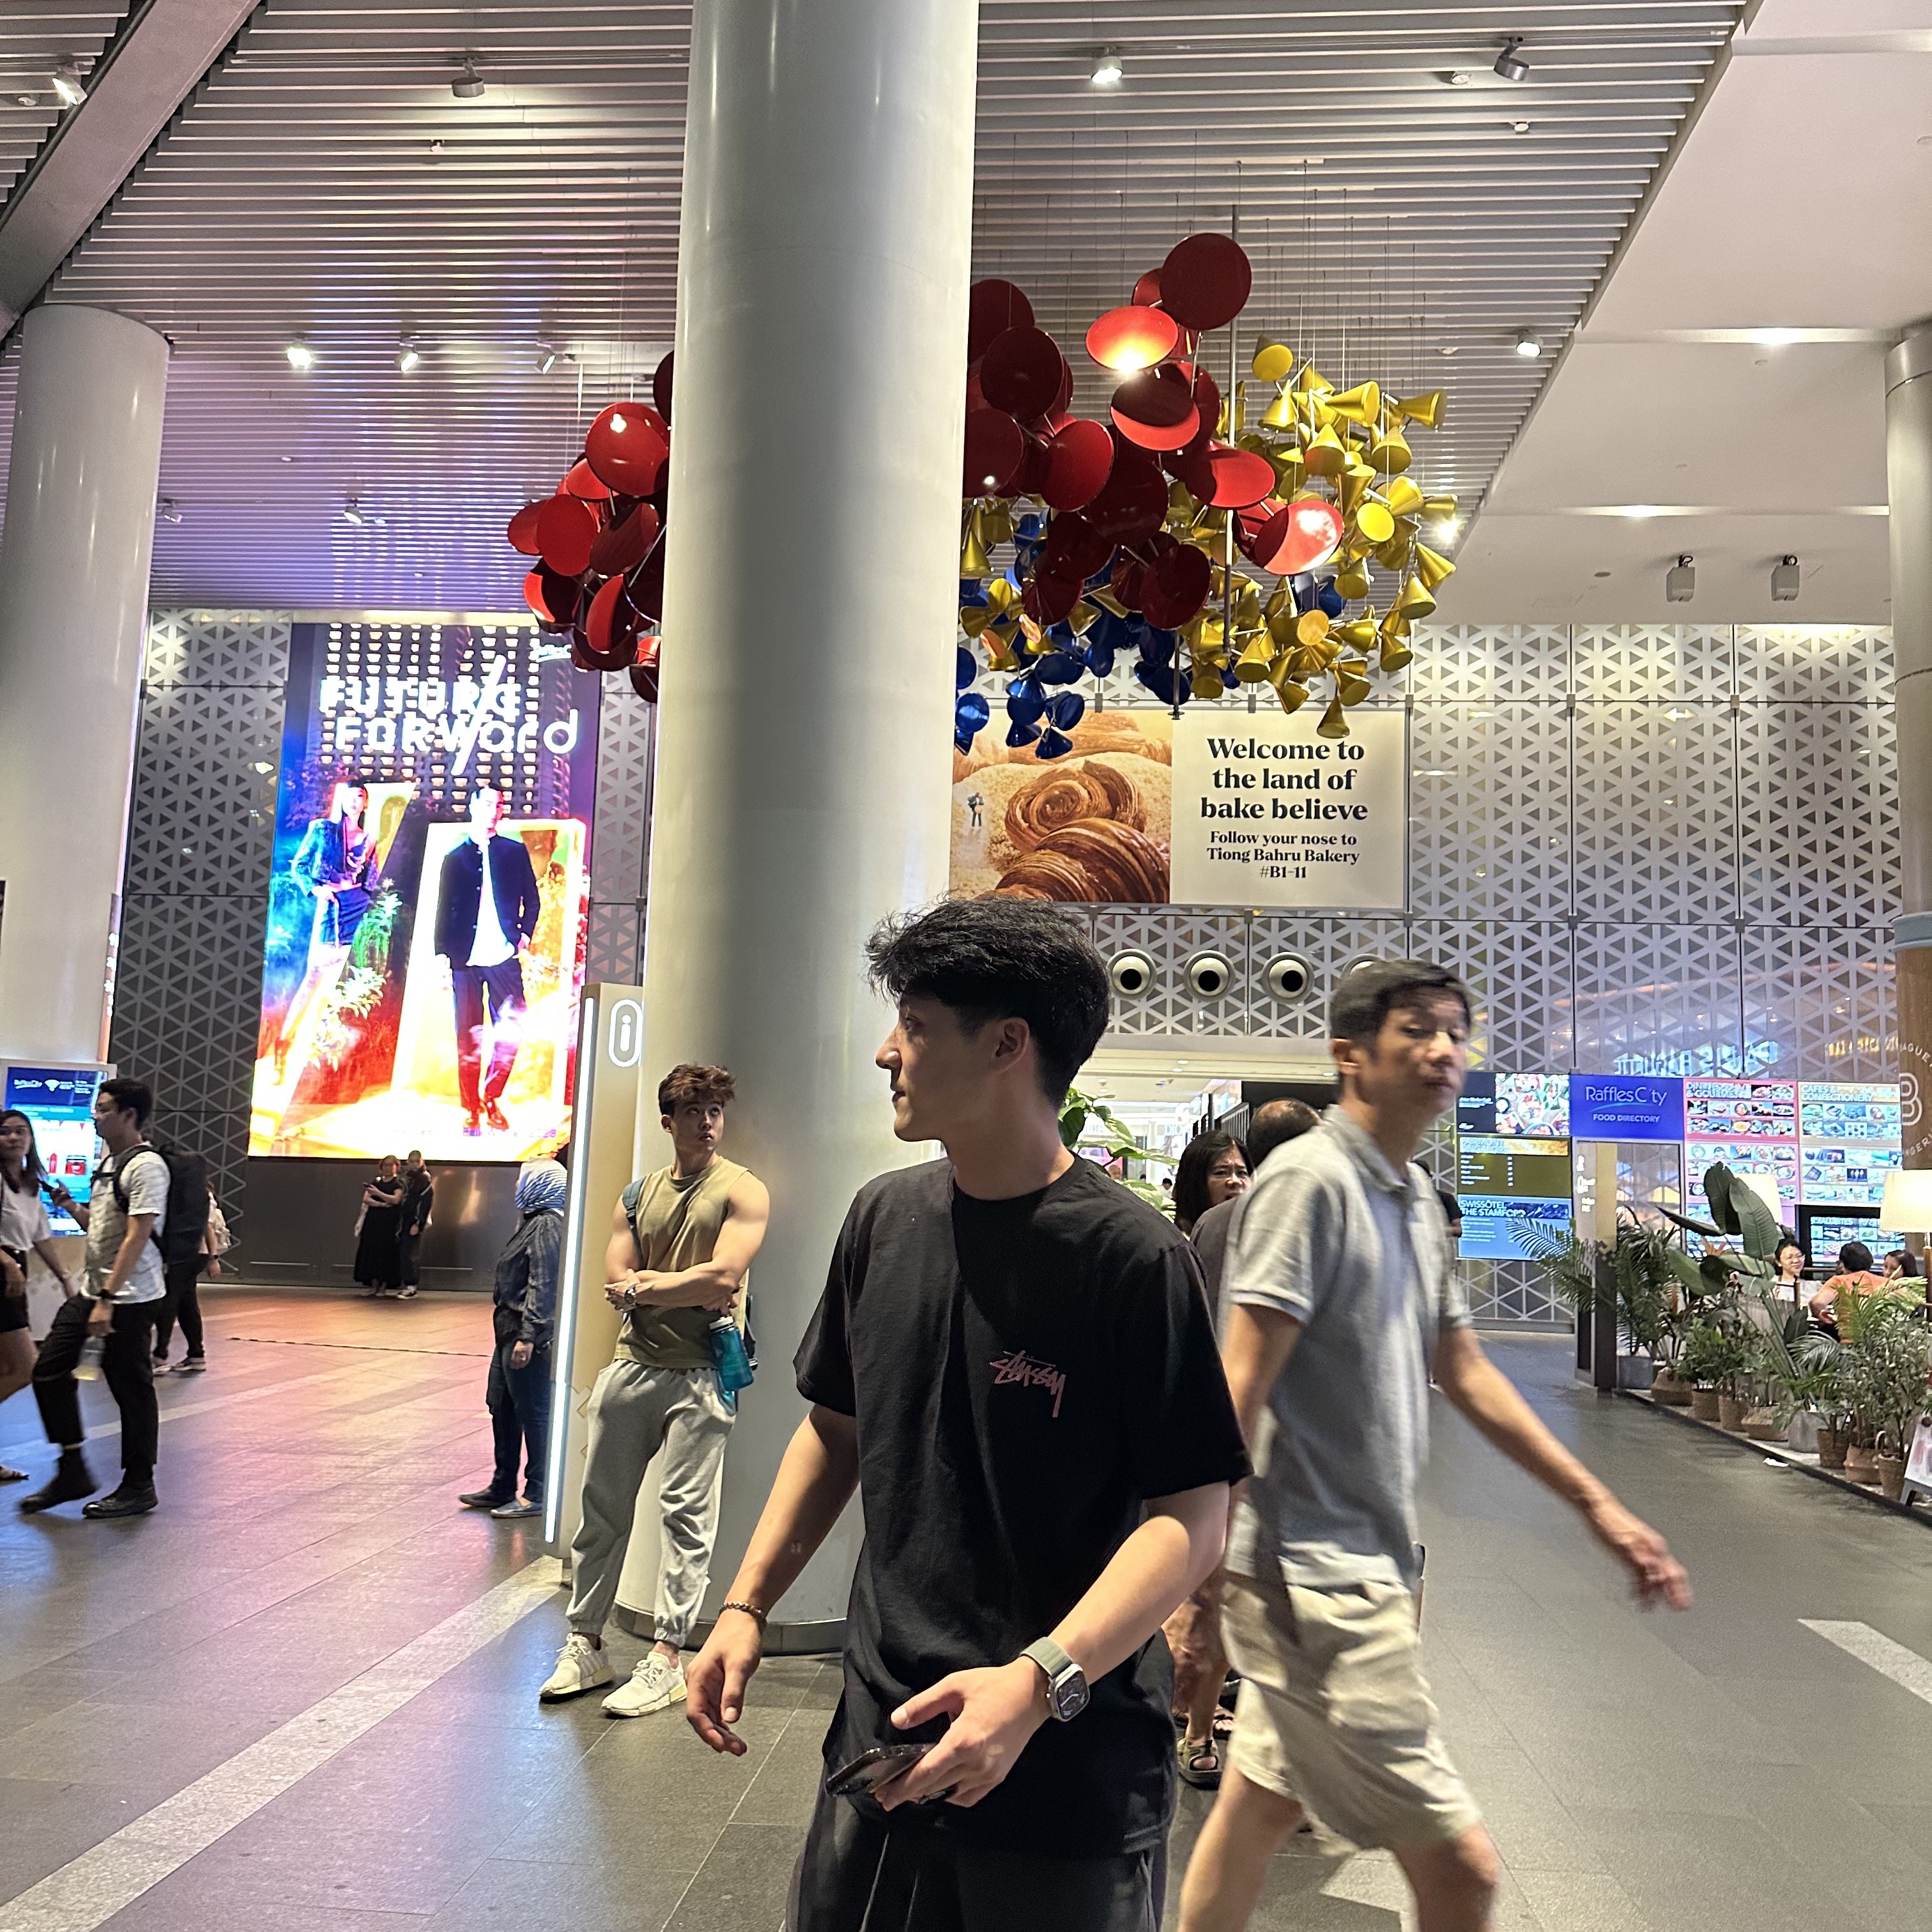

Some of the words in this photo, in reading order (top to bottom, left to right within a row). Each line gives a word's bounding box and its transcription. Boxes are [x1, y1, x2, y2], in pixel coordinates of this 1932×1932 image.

[1207, 738, 1330, 760] Welcome
[1337, 740, 1364, 760] to
[1212, 767, 1256, 788] the
[1262, 768, 1320, 789] land
[1328, 769, 1358, 790] of
[1201, 797, 1265, 818] bake
[1272, 798, 1368, 820] believe
[1210, 831, 1259, 844] Follow
[1262, 834, 1298, 847] your
[1301, 835, 1337, 845] nose
[1340, 834, 1357, 845] to
[1207, 848, 1251, 863] Tiong
[1254, 848, 1301, 861] Bahru
[1305, 850, 1360, 865] Bakery
[1259, 866, 1307, 878] #B1-11
[1801, 1084, 1828, 1093] CAFES
[1801, 1092, 1873, 1102] CONFECTIONERY
[1617, 1114, 1660, 1123] DIRECTORY
